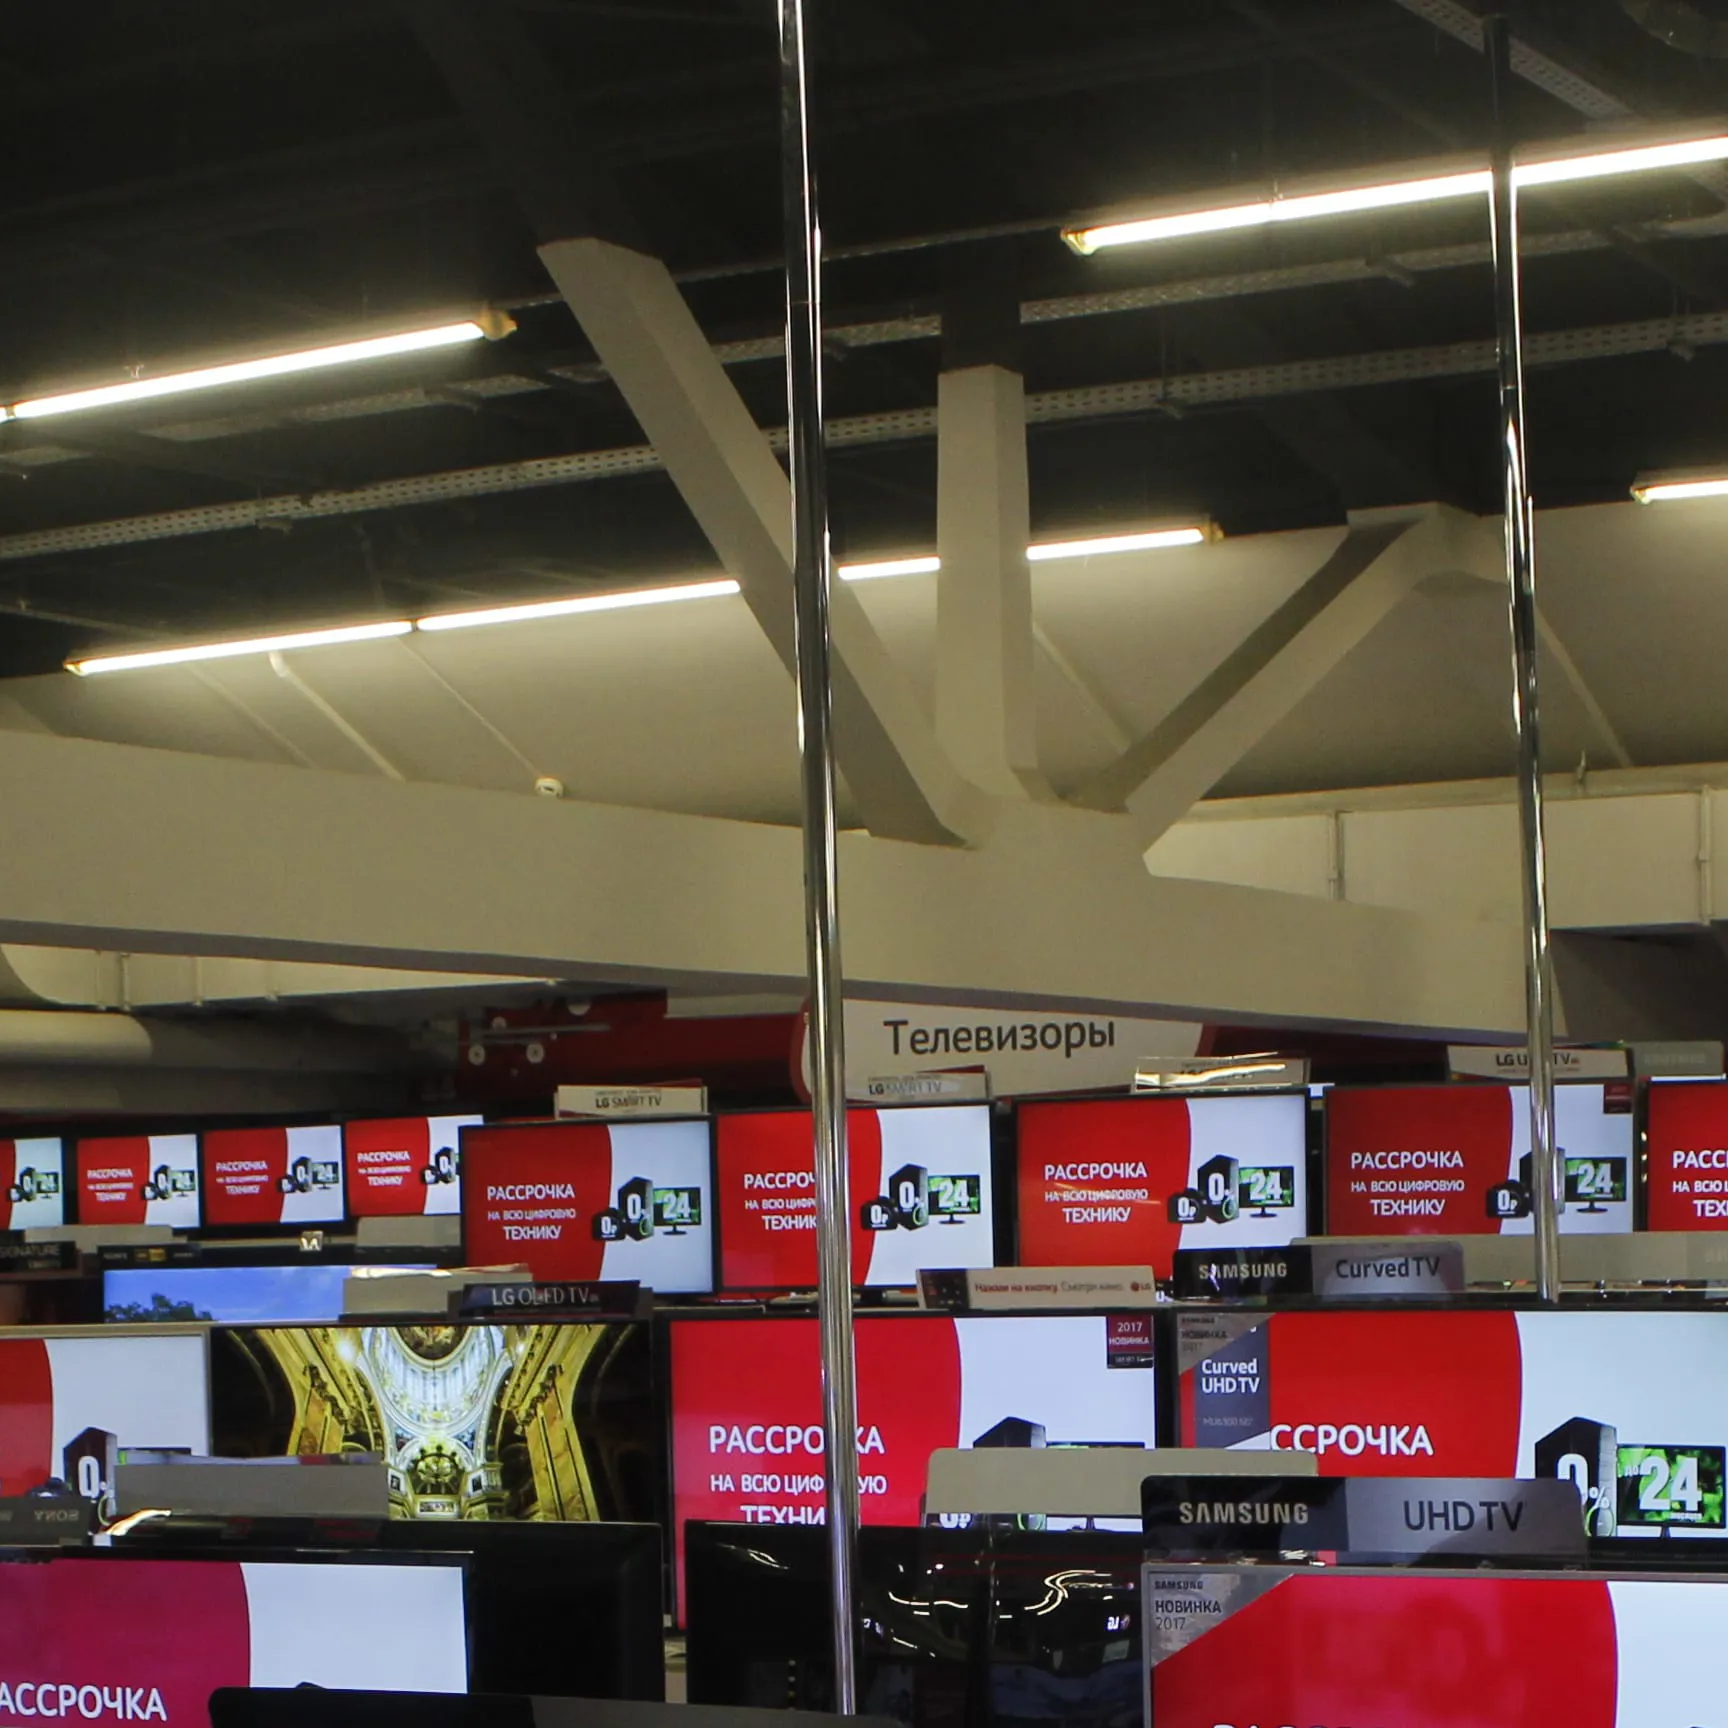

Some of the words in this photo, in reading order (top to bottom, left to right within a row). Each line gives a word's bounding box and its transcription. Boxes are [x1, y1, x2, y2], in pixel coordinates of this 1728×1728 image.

[884, 1019, 1115, 1059] Телевизоры
[1351, 1151, 1464, 1170] РАССРОЧКА
[1044, 1161, 1148, 1181] РАССРОЧКА
[487, 1183, 576, 1202] РАССРОЧКА
[1062, 1207, 1132, 1224] ТЕХНИКУ
[1370, 1197, 1445, 1216] ТЕХНИКУ
[1198, 1261, 1289, 1281] SAMSUNG
[492, 1287, 515, 1306] LG
[1117, 1322, 1143, 1333] 2017
[1201, 1358, 1258, 1375] Curved
[1639, 1456, 1703, 1513] 24
[1179, 1500, 1309, 1527] SAMSUNG
[1154, 1580, 1204, 1591] SAMSUNG
[1154, 1600, 1222, 1616] НОВИНКА
[1154, 1616, 1186, 1632] 2017
